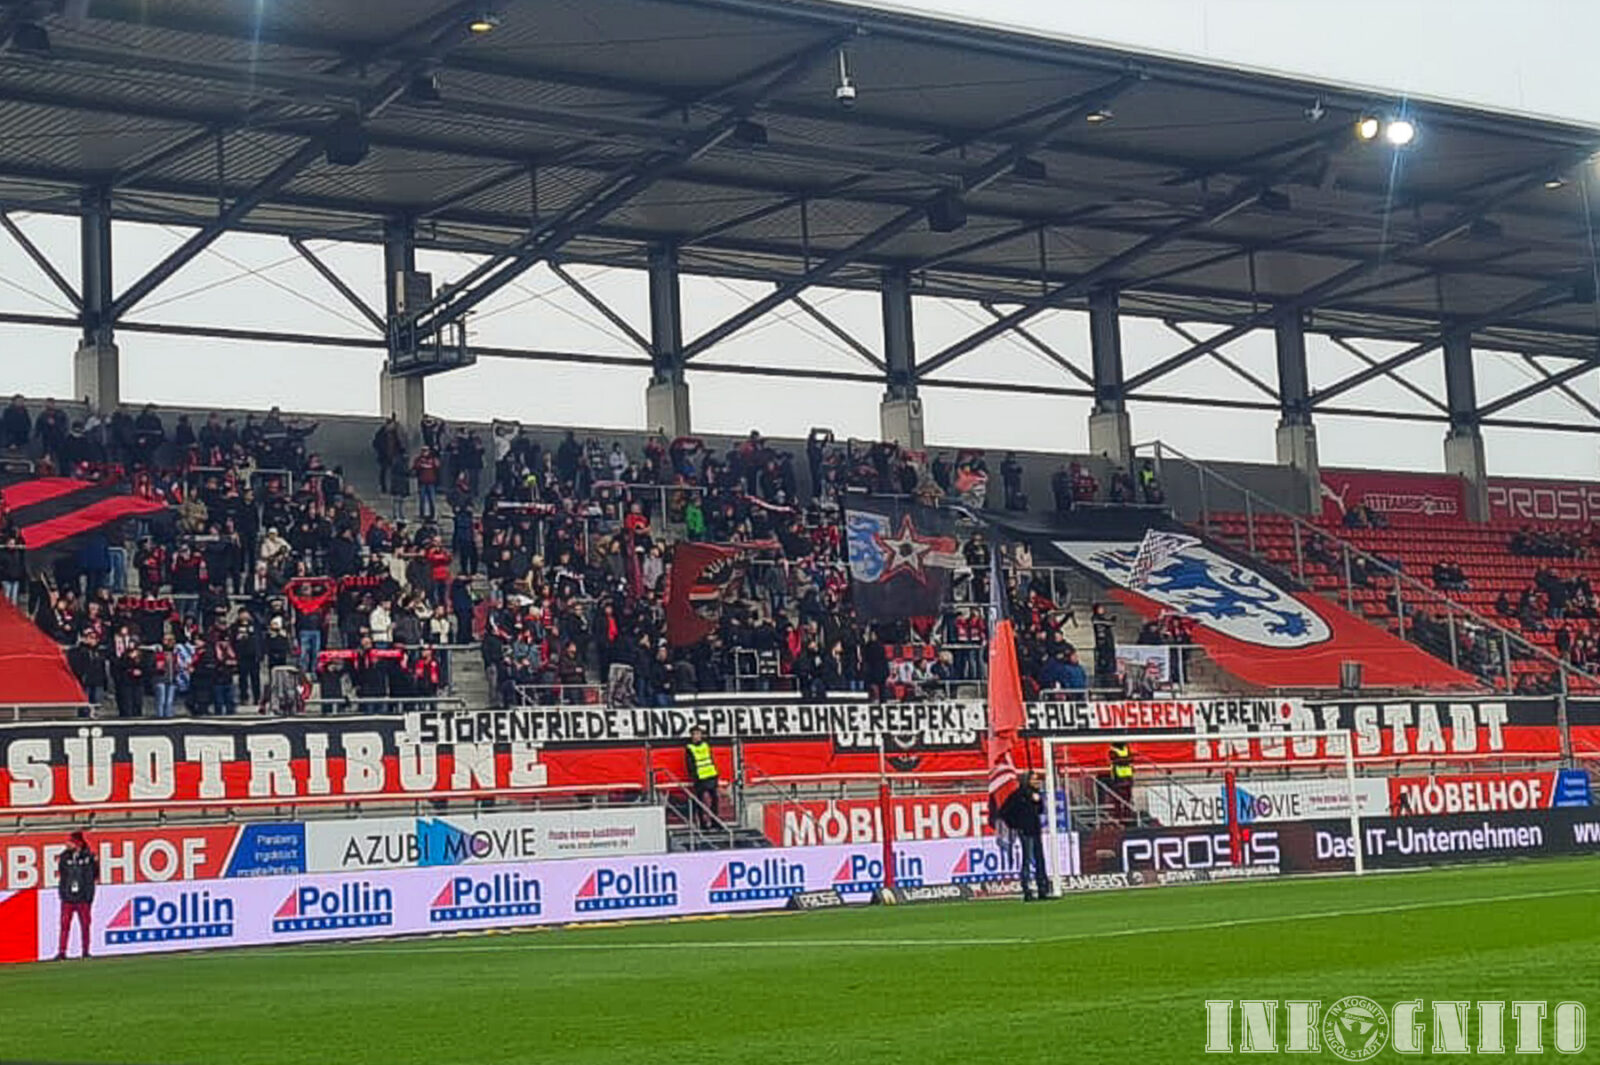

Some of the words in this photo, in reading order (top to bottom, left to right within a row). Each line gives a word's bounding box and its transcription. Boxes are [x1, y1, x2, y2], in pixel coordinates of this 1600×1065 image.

[633, 708, 688, 736] UND
[694, 705, 790, 735] SPIELER
[799, 704, 859, 733] OHNE
[869, 703, 966, 733] RESPEKT
[1044, 701, 1090, 729] AUS
[1094, 699, 1193, 729] UNSEREM
[1197, 700, 1277, 726] VEREIN!
[342, 832, 430, 866] AZUBI
[443, 827, 536, 862] MOVIE
[1316, 831, 1356, 858] Das
[1366, 822, 1543, 855] IT-Unternehmen
[455, 873, 541, 905] Pollin
[597, 865, 678, 896] Pollin
[728, 857, 804, 888] Pollin
[133, 891, 233, 927] Pollin
[299, 881, 392, 915] Pollin
